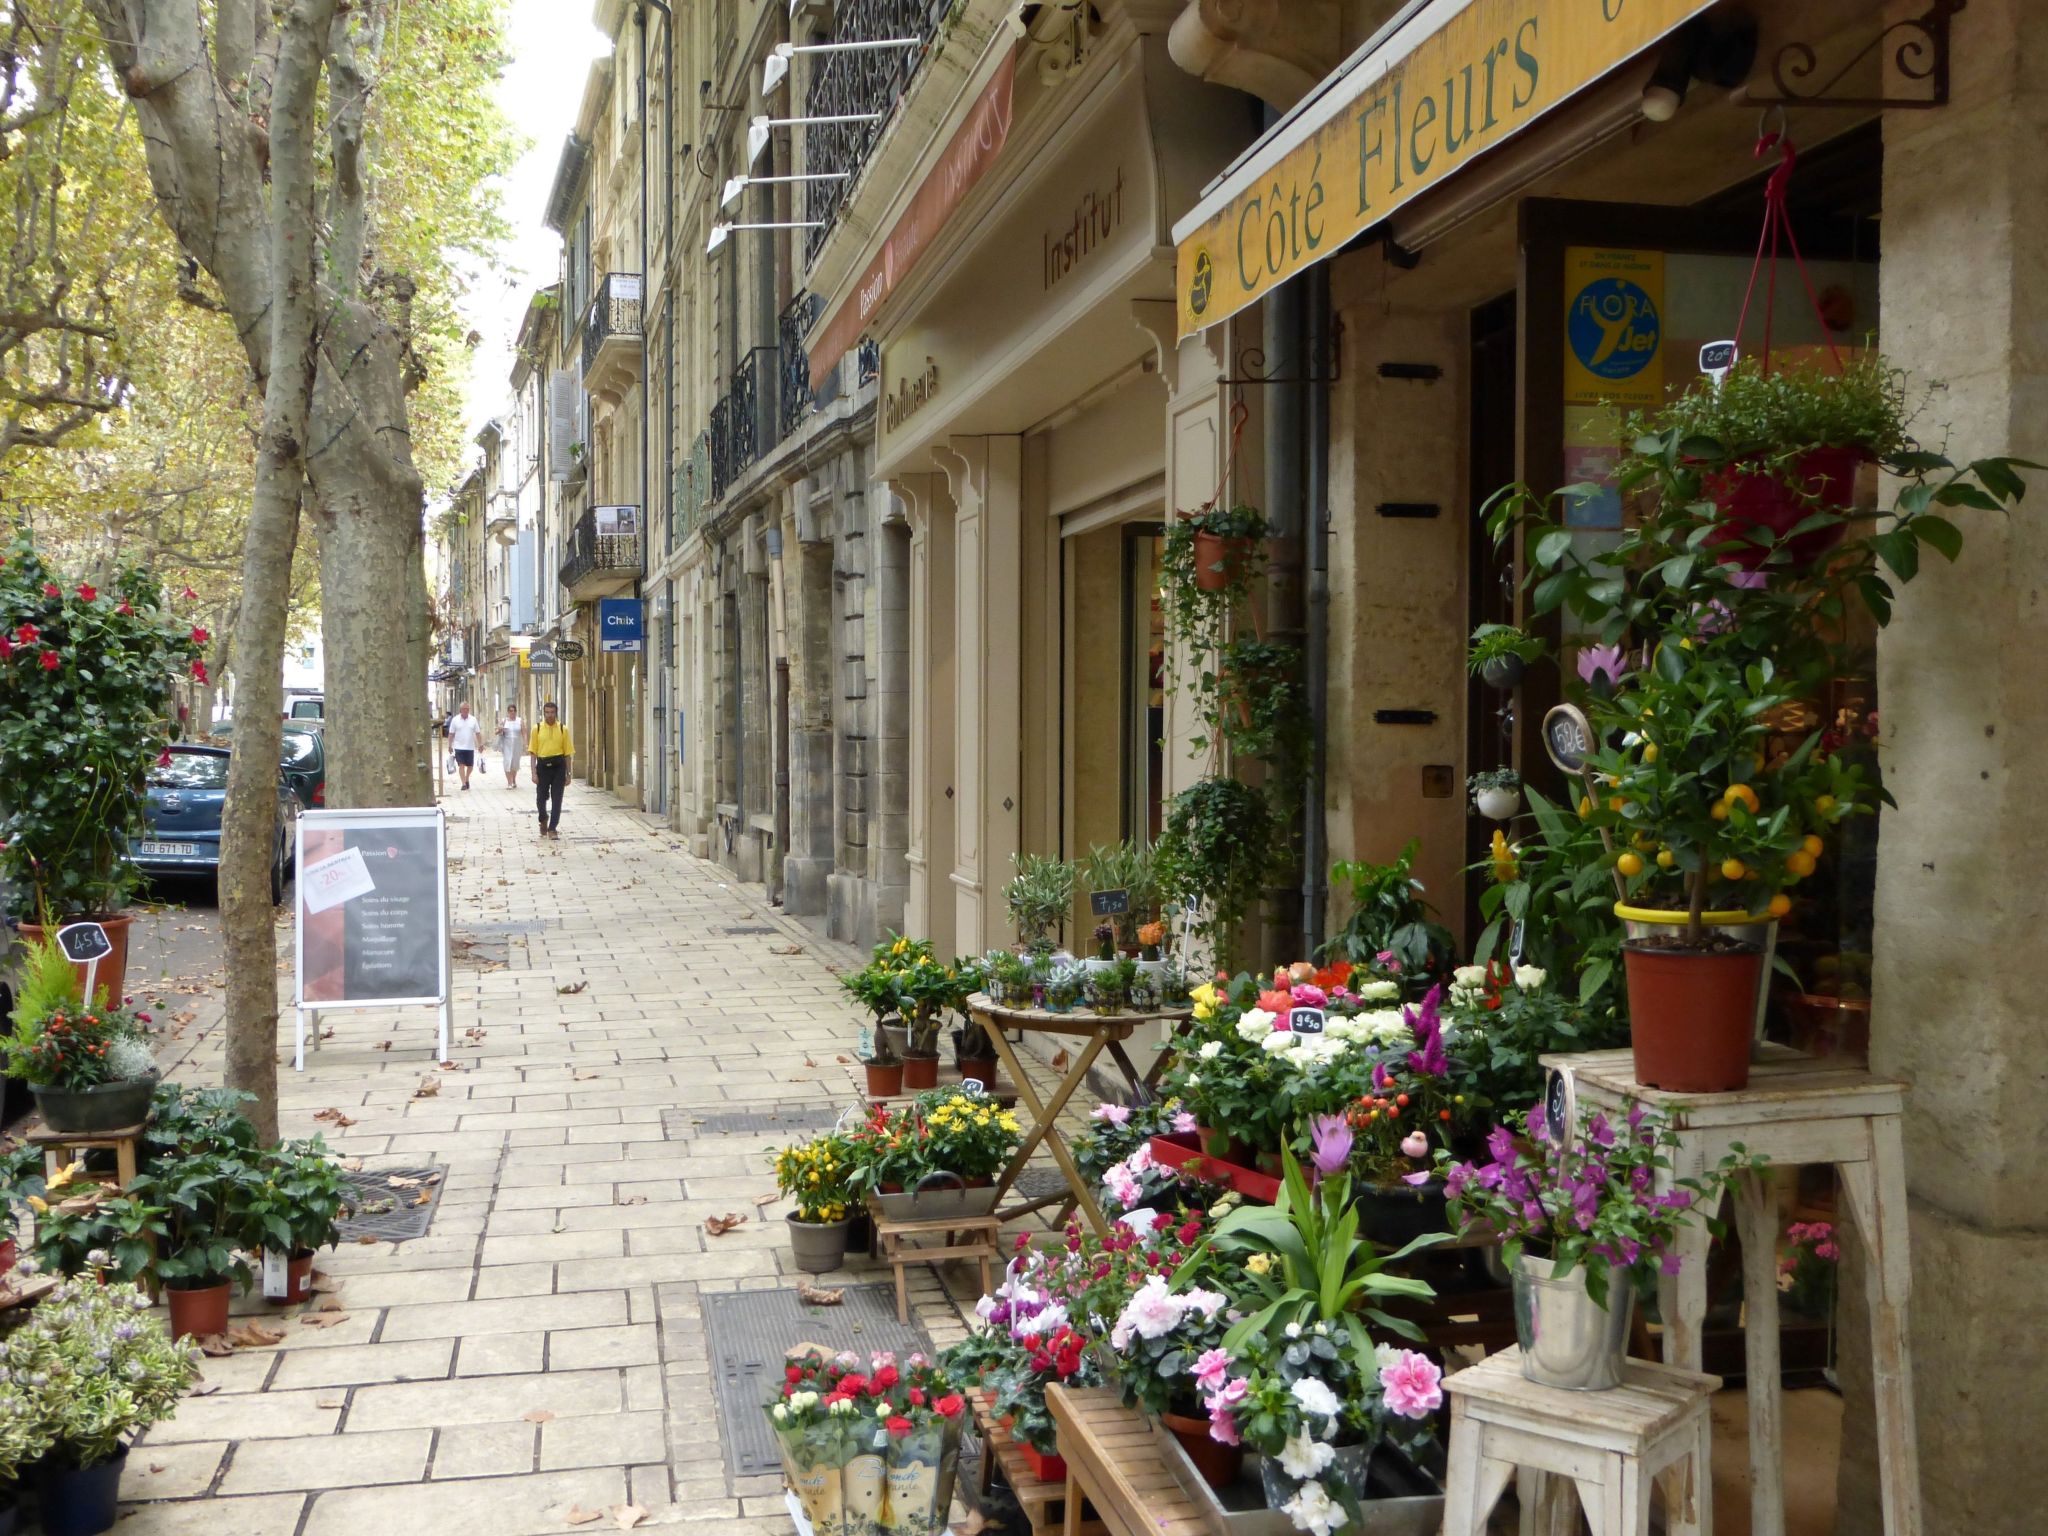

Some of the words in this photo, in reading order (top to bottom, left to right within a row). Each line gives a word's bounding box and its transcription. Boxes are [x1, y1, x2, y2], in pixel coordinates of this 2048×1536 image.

[1237, 153, 1325, 292] Côté
[1355, 15, 1540, 219] Fleurs
[1043, 165, 1123, 291] Institut
[860, 271, 883, 321] Passion
[1579, 294, 1655, 319] FLORA
[1618, 325, 1656, 353] Jet
